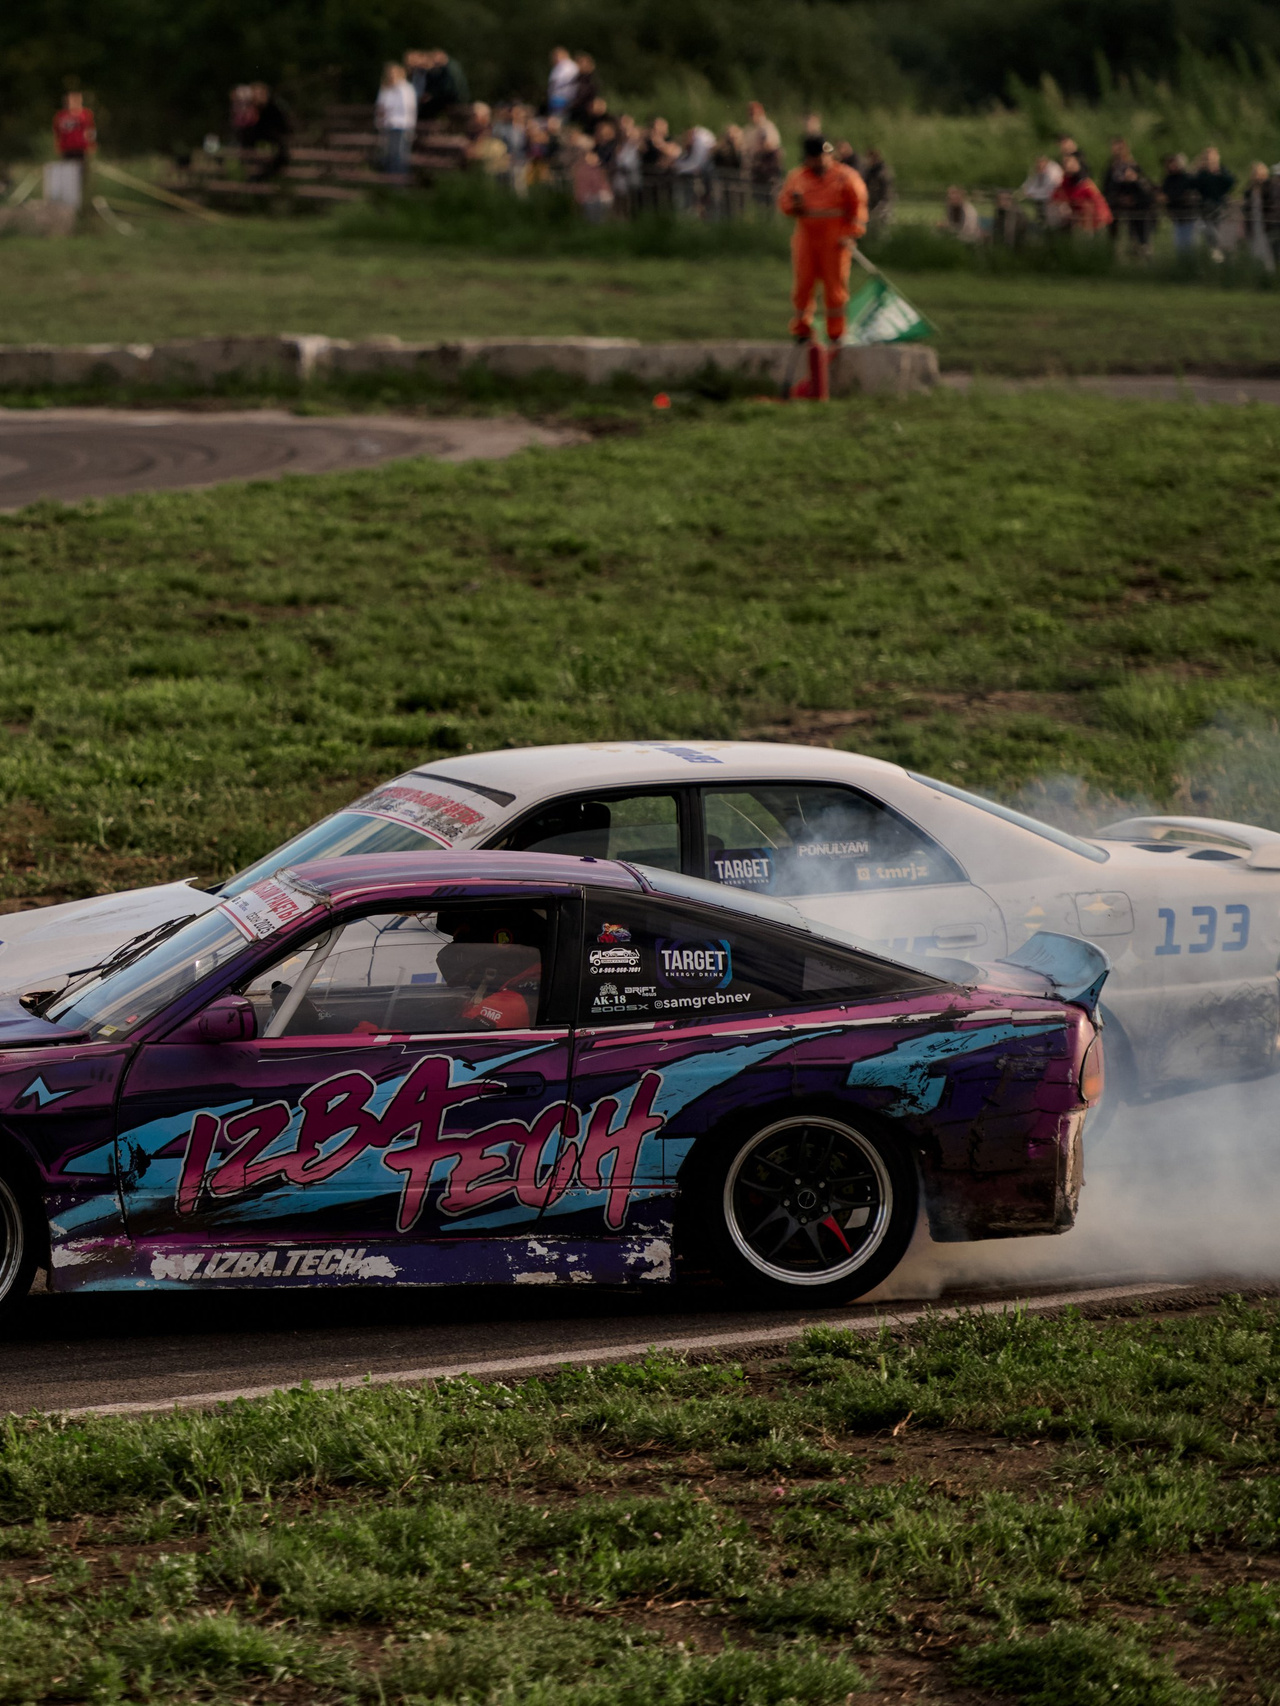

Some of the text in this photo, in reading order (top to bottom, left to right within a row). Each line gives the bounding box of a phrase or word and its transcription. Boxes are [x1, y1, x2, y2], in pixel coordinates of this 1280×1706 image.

[798, 840, 870, 857] PONULYAM
[714, 858, 770, 879] TARGET
[1154, 903, 1251, 956] 133
[661, 950, 726, 971] TARGET
[624, 986, 657, 995] DRIFT
[591, 1004, 649, 1013] 200SX
[593, 995, 627, 1006] AK-18
[663, 991, 752, 1010] samgrebnev
[480, 1007, 502, 1021] OMP
[175, 1054, 508, 1216] IZBA
[381, 1069, 668, 1234] TECH
